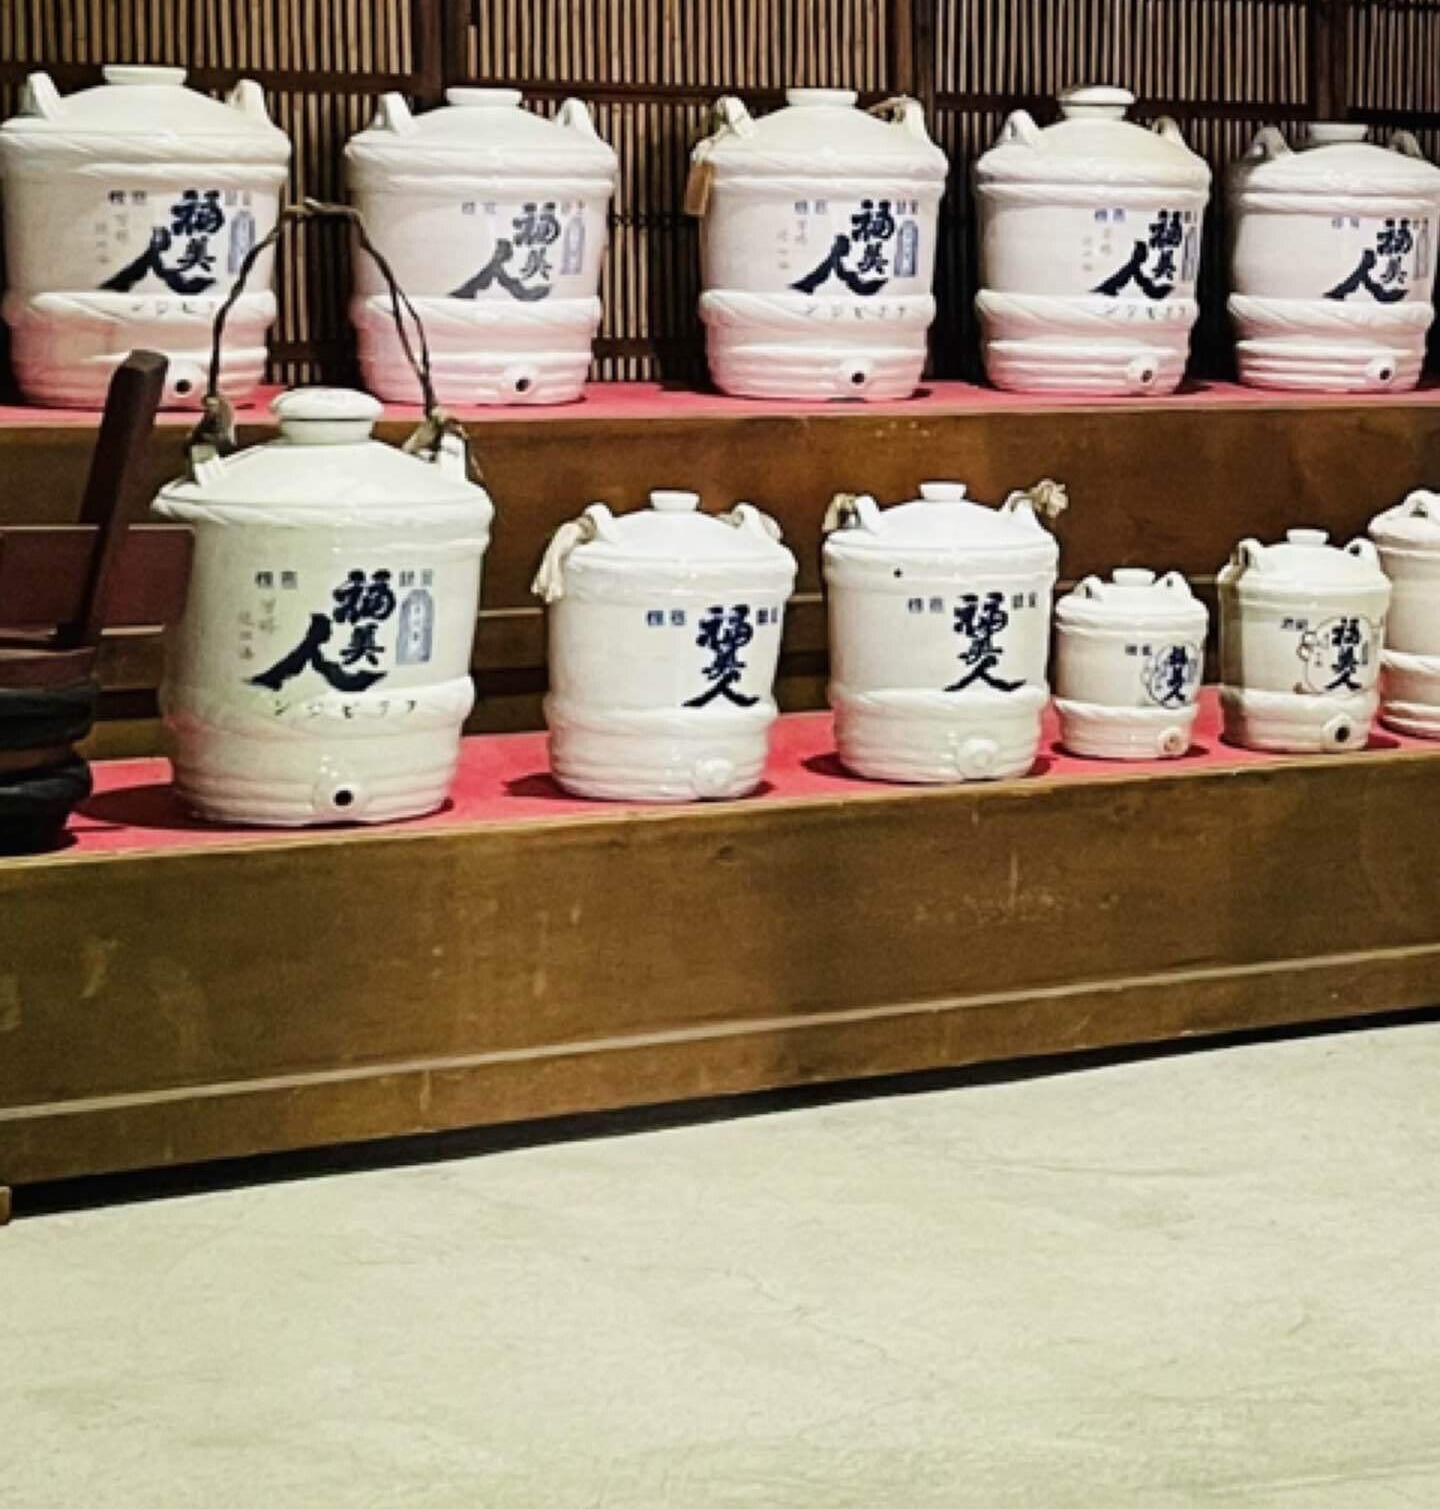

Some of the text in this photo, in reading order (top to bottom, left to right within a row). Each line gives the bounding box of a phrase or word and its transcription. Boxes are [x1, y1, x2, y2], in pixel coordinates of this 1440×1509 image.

[101, 189, 225, 293] 福美人
[450, 203, 561, 301] 福美人
[790, 200, 895, 296] 福美人
[1093, 209, 1182, 297] 福美人
[1324, 217, 1413, 302] 福美人
[247, 568, 396, 692] 福美人
[681, 604, 759, 707] 福美人
[944, 593, 1027, 692] 福美人
